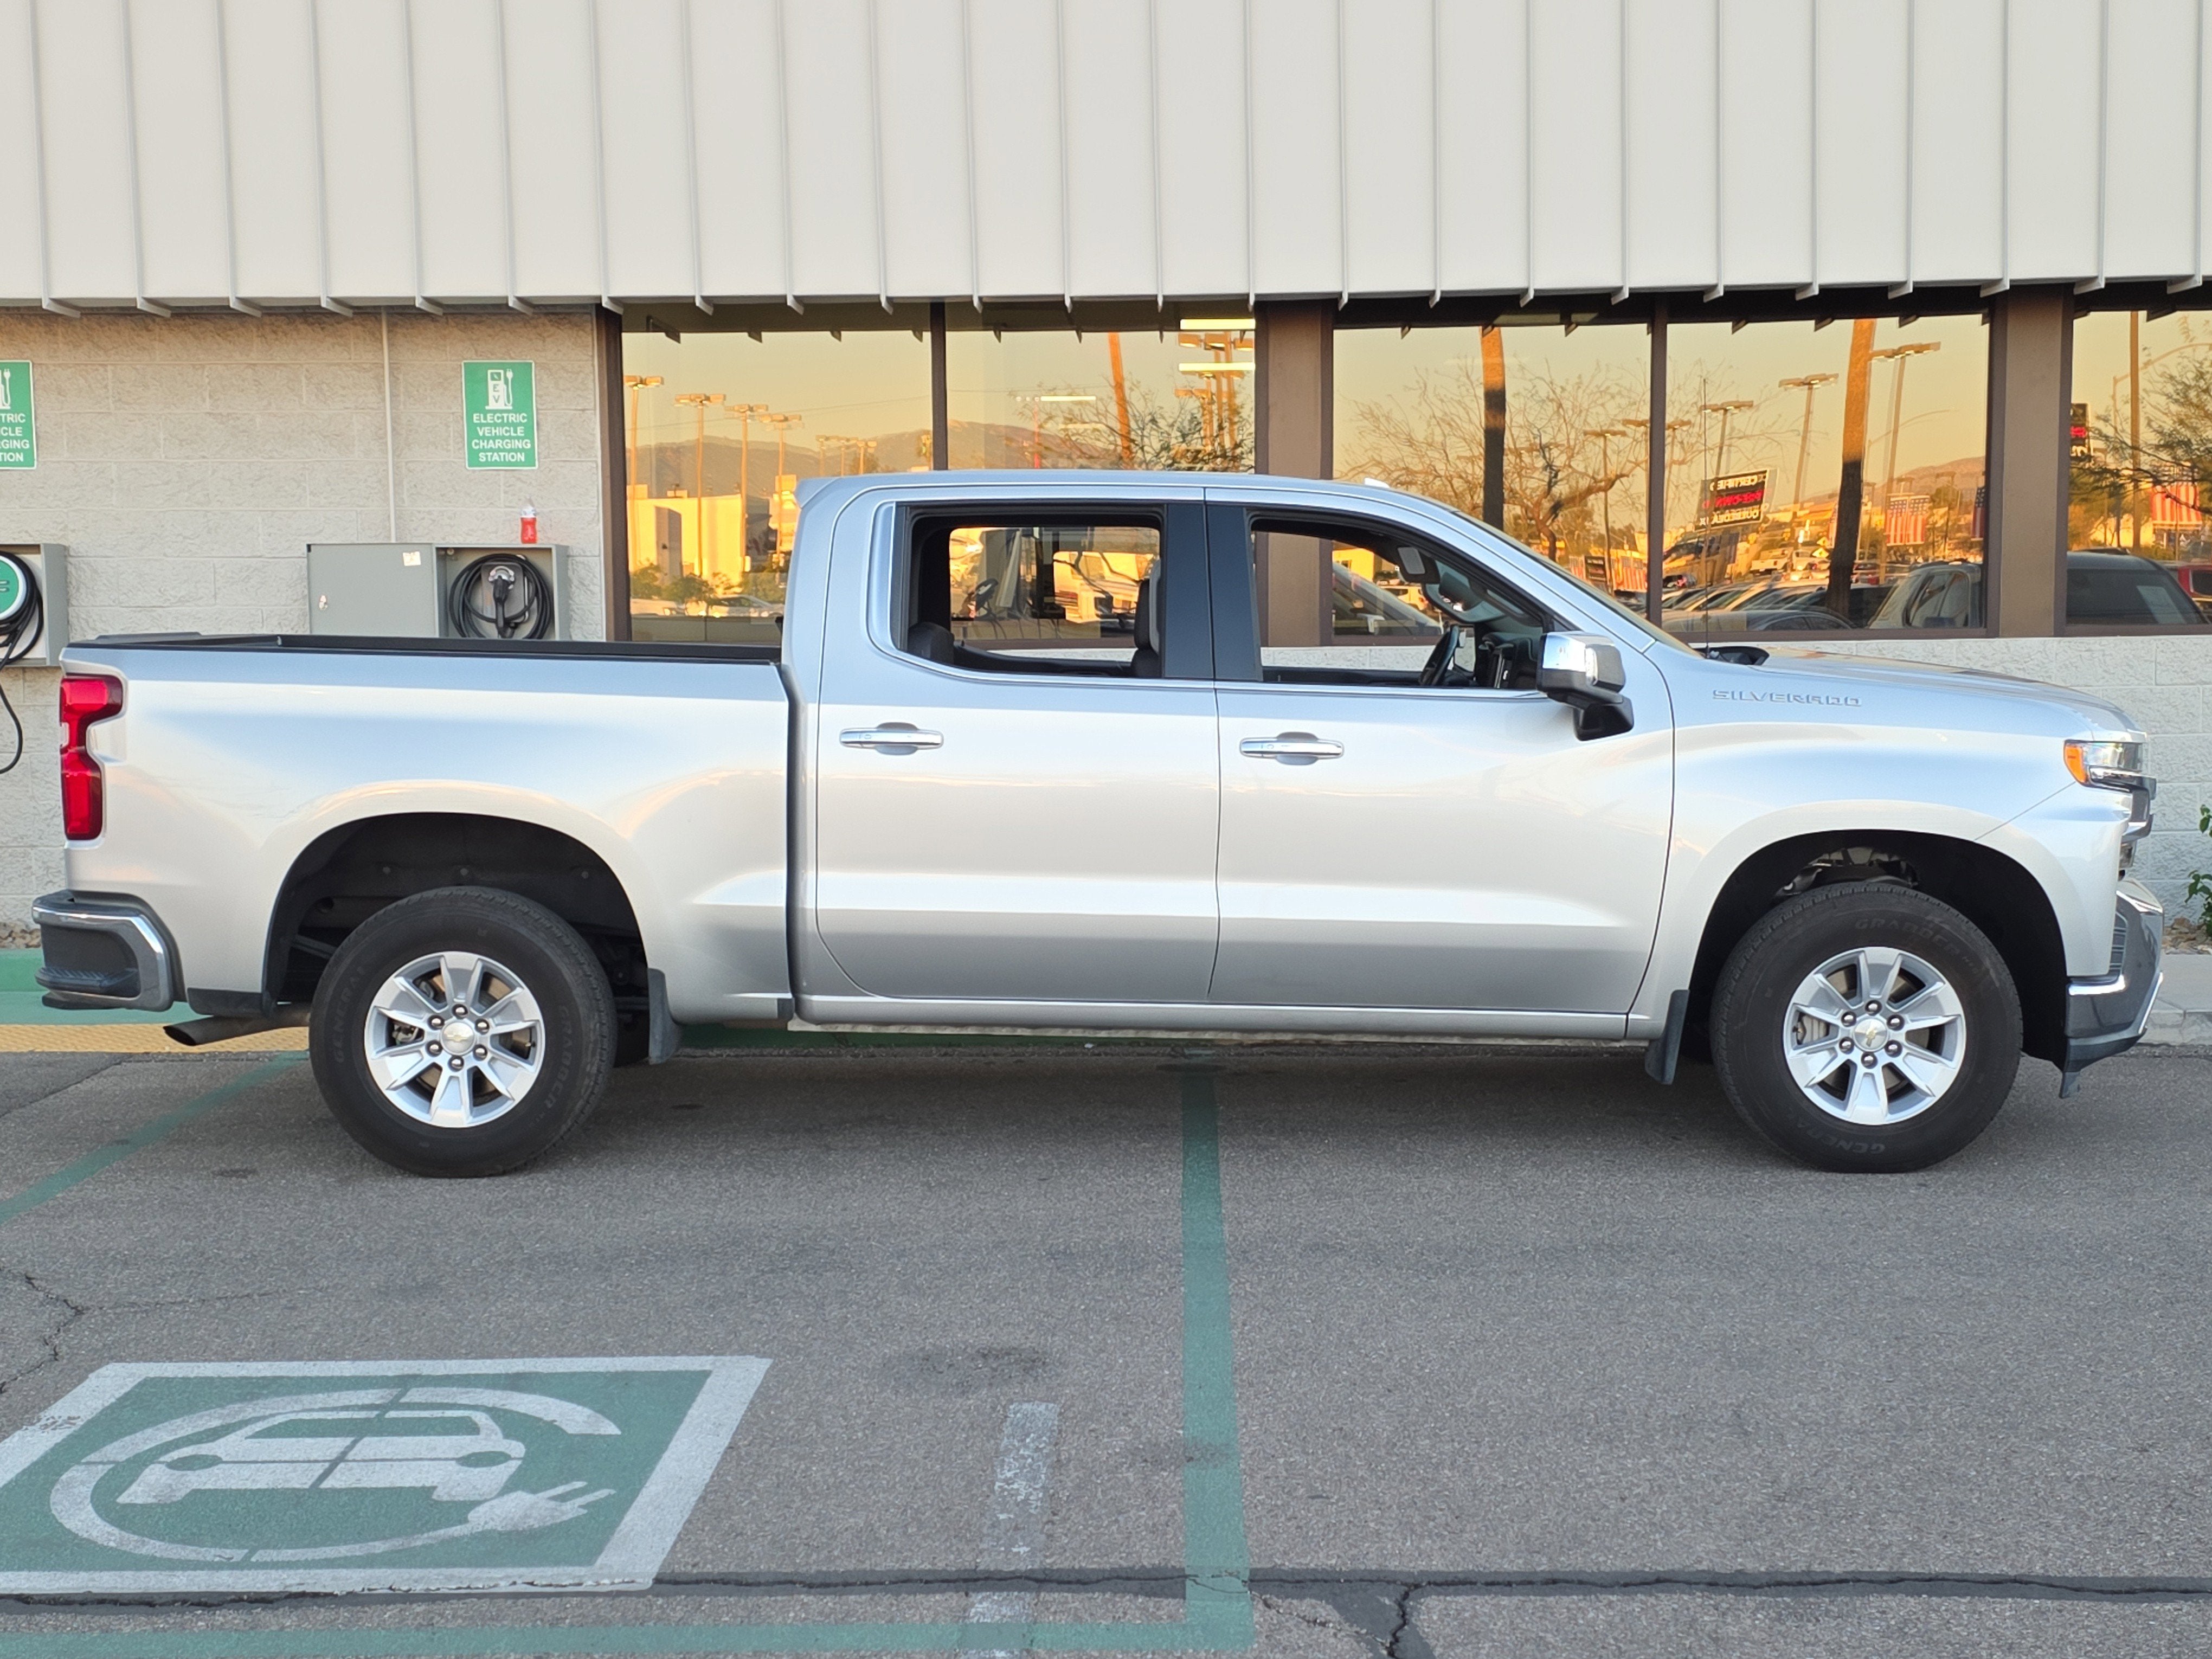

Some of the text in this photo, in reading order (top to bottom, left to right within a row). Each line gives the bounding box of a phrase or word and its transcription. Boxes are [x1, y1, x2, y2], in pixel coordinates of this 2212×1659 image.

[473, 413, 528, 423] ELECTRIC
[477, 427, 525, 436] VEHICLE
[472, 439, 531, 449] CHARGING
[479, 452, 525, 462] STATION
[1713, 689, 1862, 706] SILVERADO
